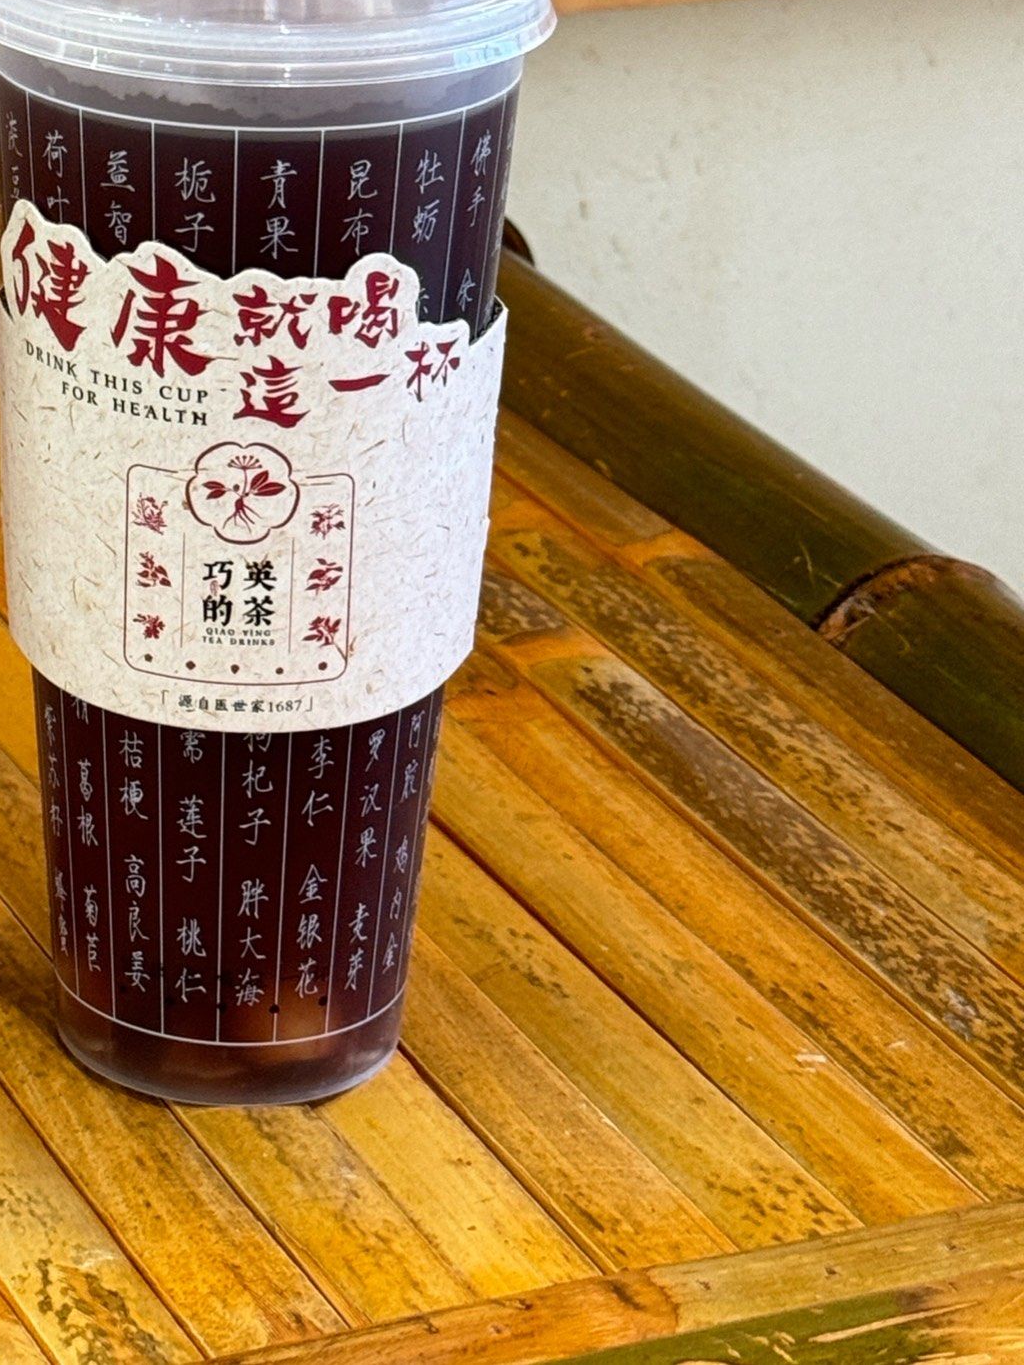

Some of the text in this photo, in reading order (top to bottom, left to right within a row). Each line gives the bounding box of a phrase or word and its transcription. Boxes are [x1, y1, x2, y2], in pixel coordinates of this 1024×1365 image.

[174, 157, 216, 254] 栀子
[259, 158, 300, 260] 青果
[340, 158, 379, 256] 昆布
[11, 218, 400, 379] 健康就喝
[25, 340, 210, 404] DRINK THIS CUP
[61, 380, 209, 427] FOR HEALTH
[232, 339, 461, 429] 這一杯
[118, 729, 149, 820] 桔梗
[176, 793, 207, 883] 莲子
[175, 916, 208, 1004] 桃仁
[234, 878, 269, 1008] 胖大海
[294, 863, 329, 1000] 金银花
